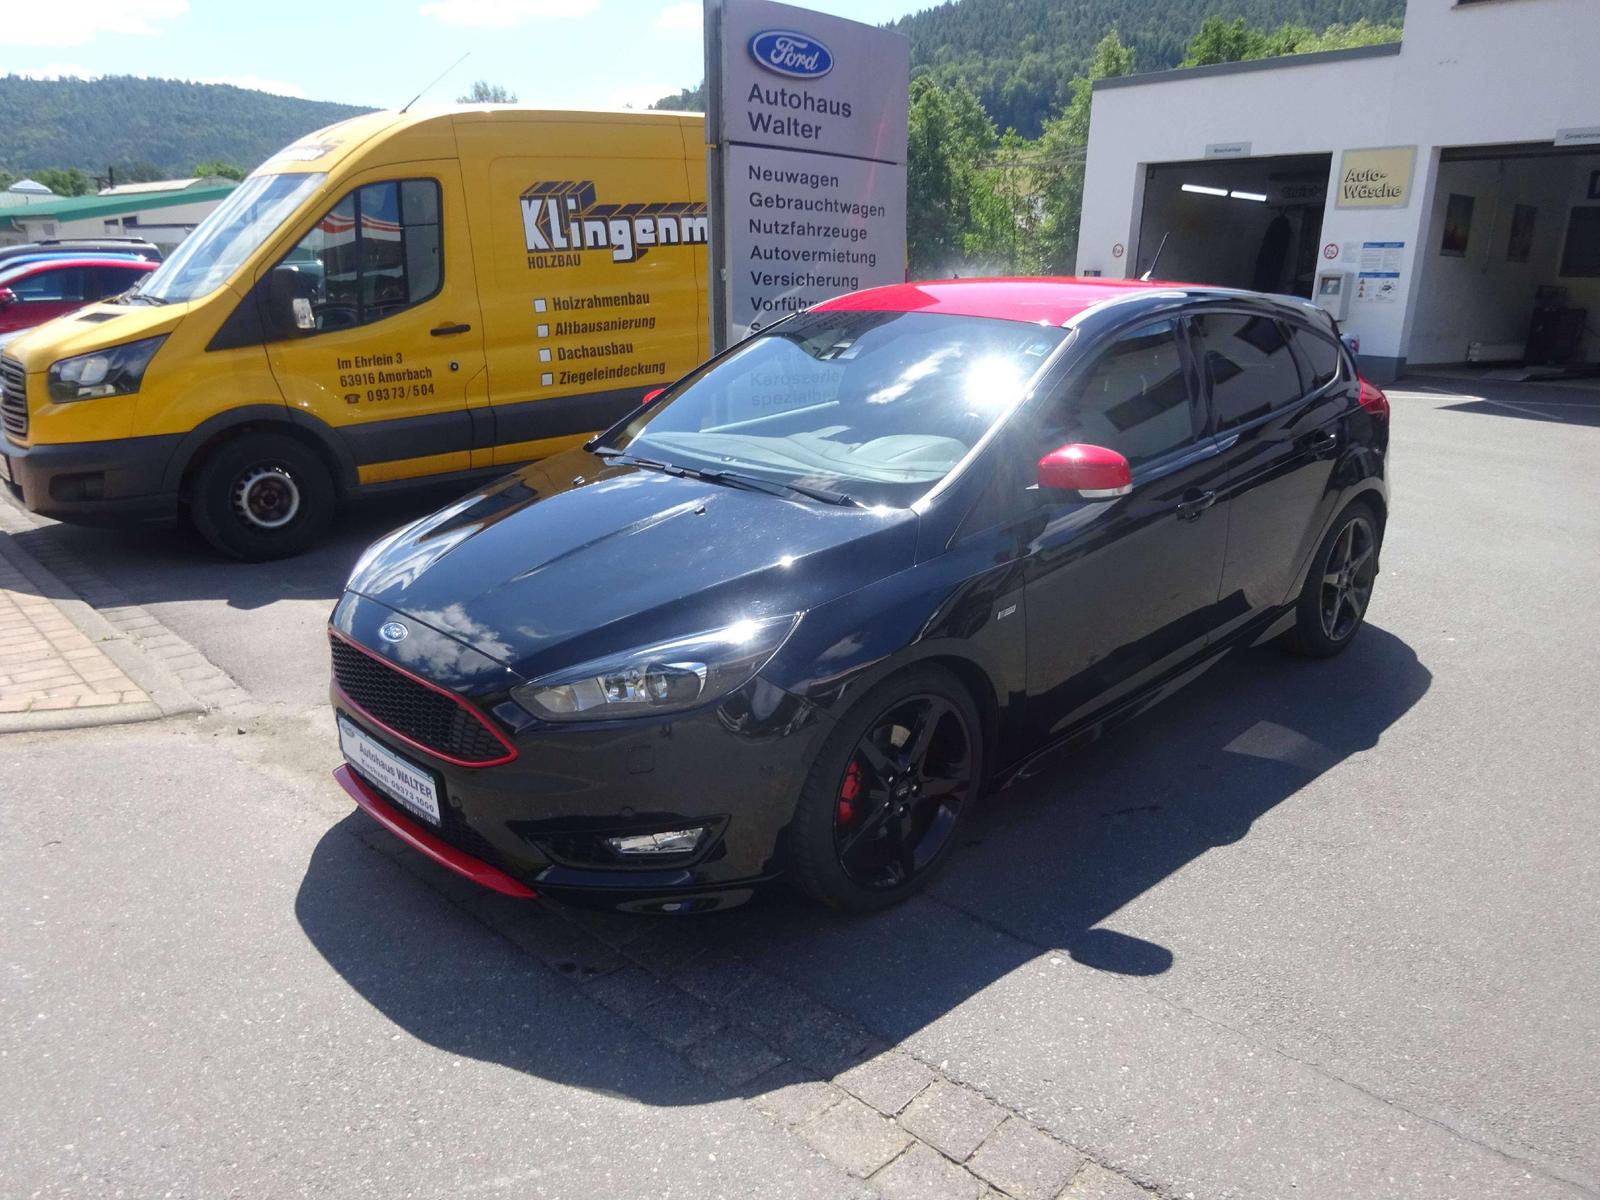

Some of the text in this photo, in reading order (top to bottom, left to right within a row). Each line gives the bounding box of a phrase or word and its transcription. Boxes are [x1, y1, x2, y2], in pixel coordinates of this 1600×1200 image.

[770, 37, 820, 72] Ford
[748, 83, 852, 118] Autohaus
[748, 111, 822, 140] Walter
[749, 165, 839, 188] Neuwagen
[1344, 168, 1387, 183] Auto-
[1344, 183, 1402, 199] Wäsche
[749, 192, 885, 219] Gebrauchtwagen
[749, 219, 868, 242] Nutzfahrzeuge
[528, 254, 581, 270] HOLZBAU
[750, 245, 877, 267] Autovermietung
[750, 271, 859, 290] Versicherung
[552, 292, 650, 312] Holzrahmenbau
[750, 296, 818, 312] Vorführ
[555, 316, 656, 337] Altbausanierung
[337, 352, 403, 370] Im Ehrlein 3
[557, 342, 634, 361] Dachausbau
[340, 367, 432, 388] 63916 Amorbach
[559, 361, 666, 386] Ziegeleindeckung
[359, 742, 433, 801] Autohaus WALTER
